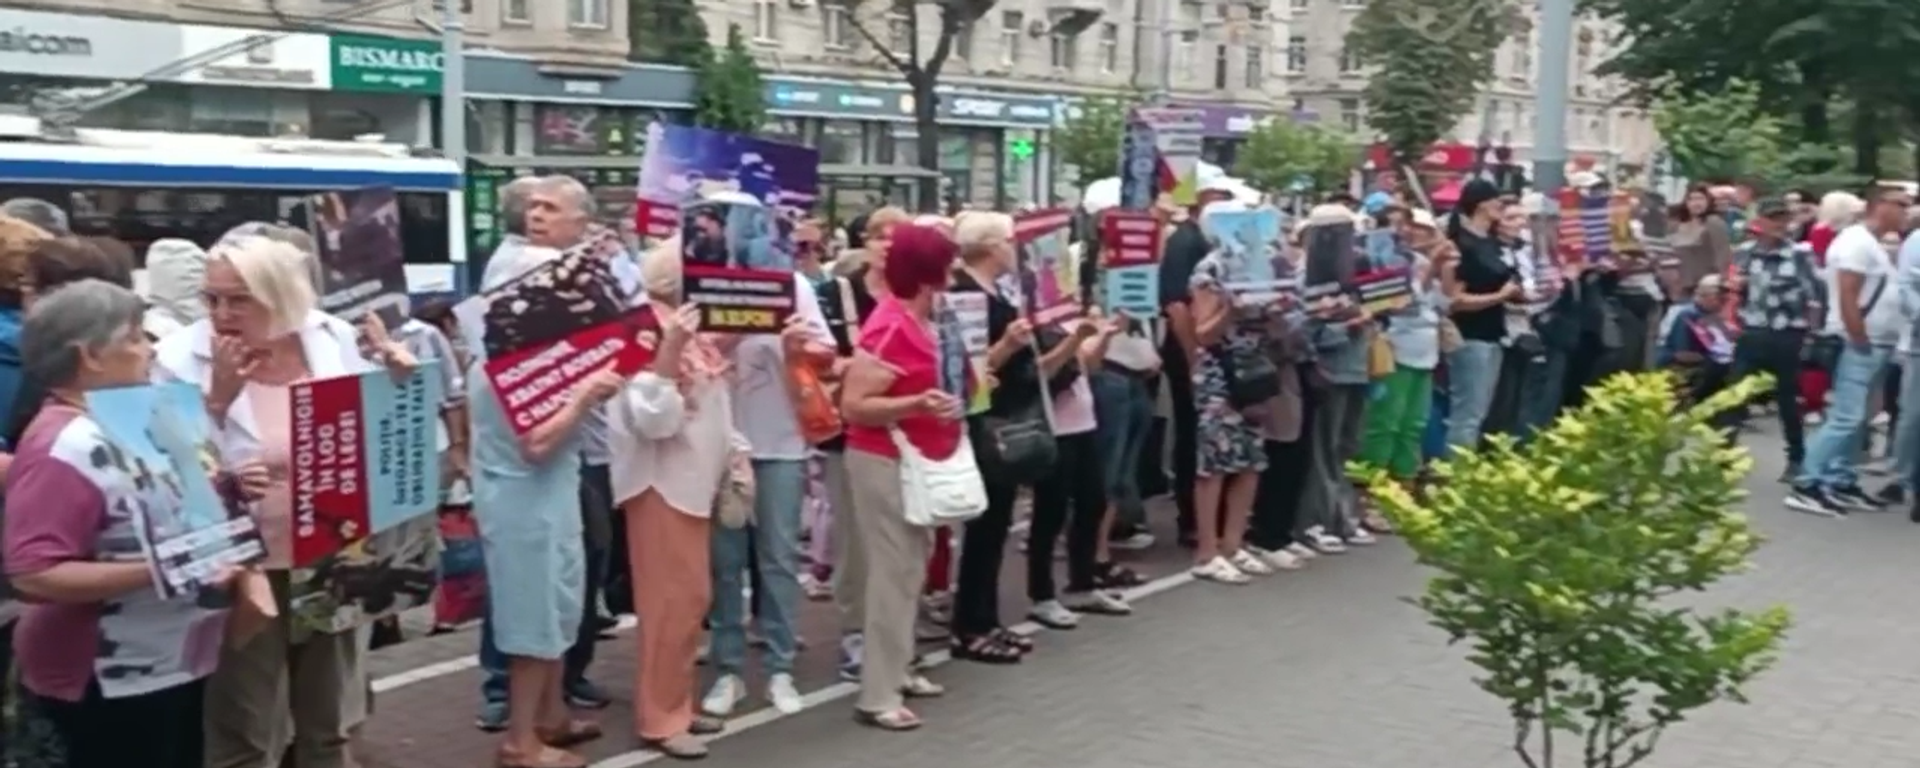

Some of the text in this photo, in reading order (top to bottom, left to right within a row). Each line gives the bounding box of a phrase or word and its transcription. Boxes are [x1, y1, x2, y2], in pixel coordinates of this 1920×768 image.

[515, 411, 534, 426] С
[316, 423, 335, 492] ÎN LOC
[339, 467, 357, 494] DE
